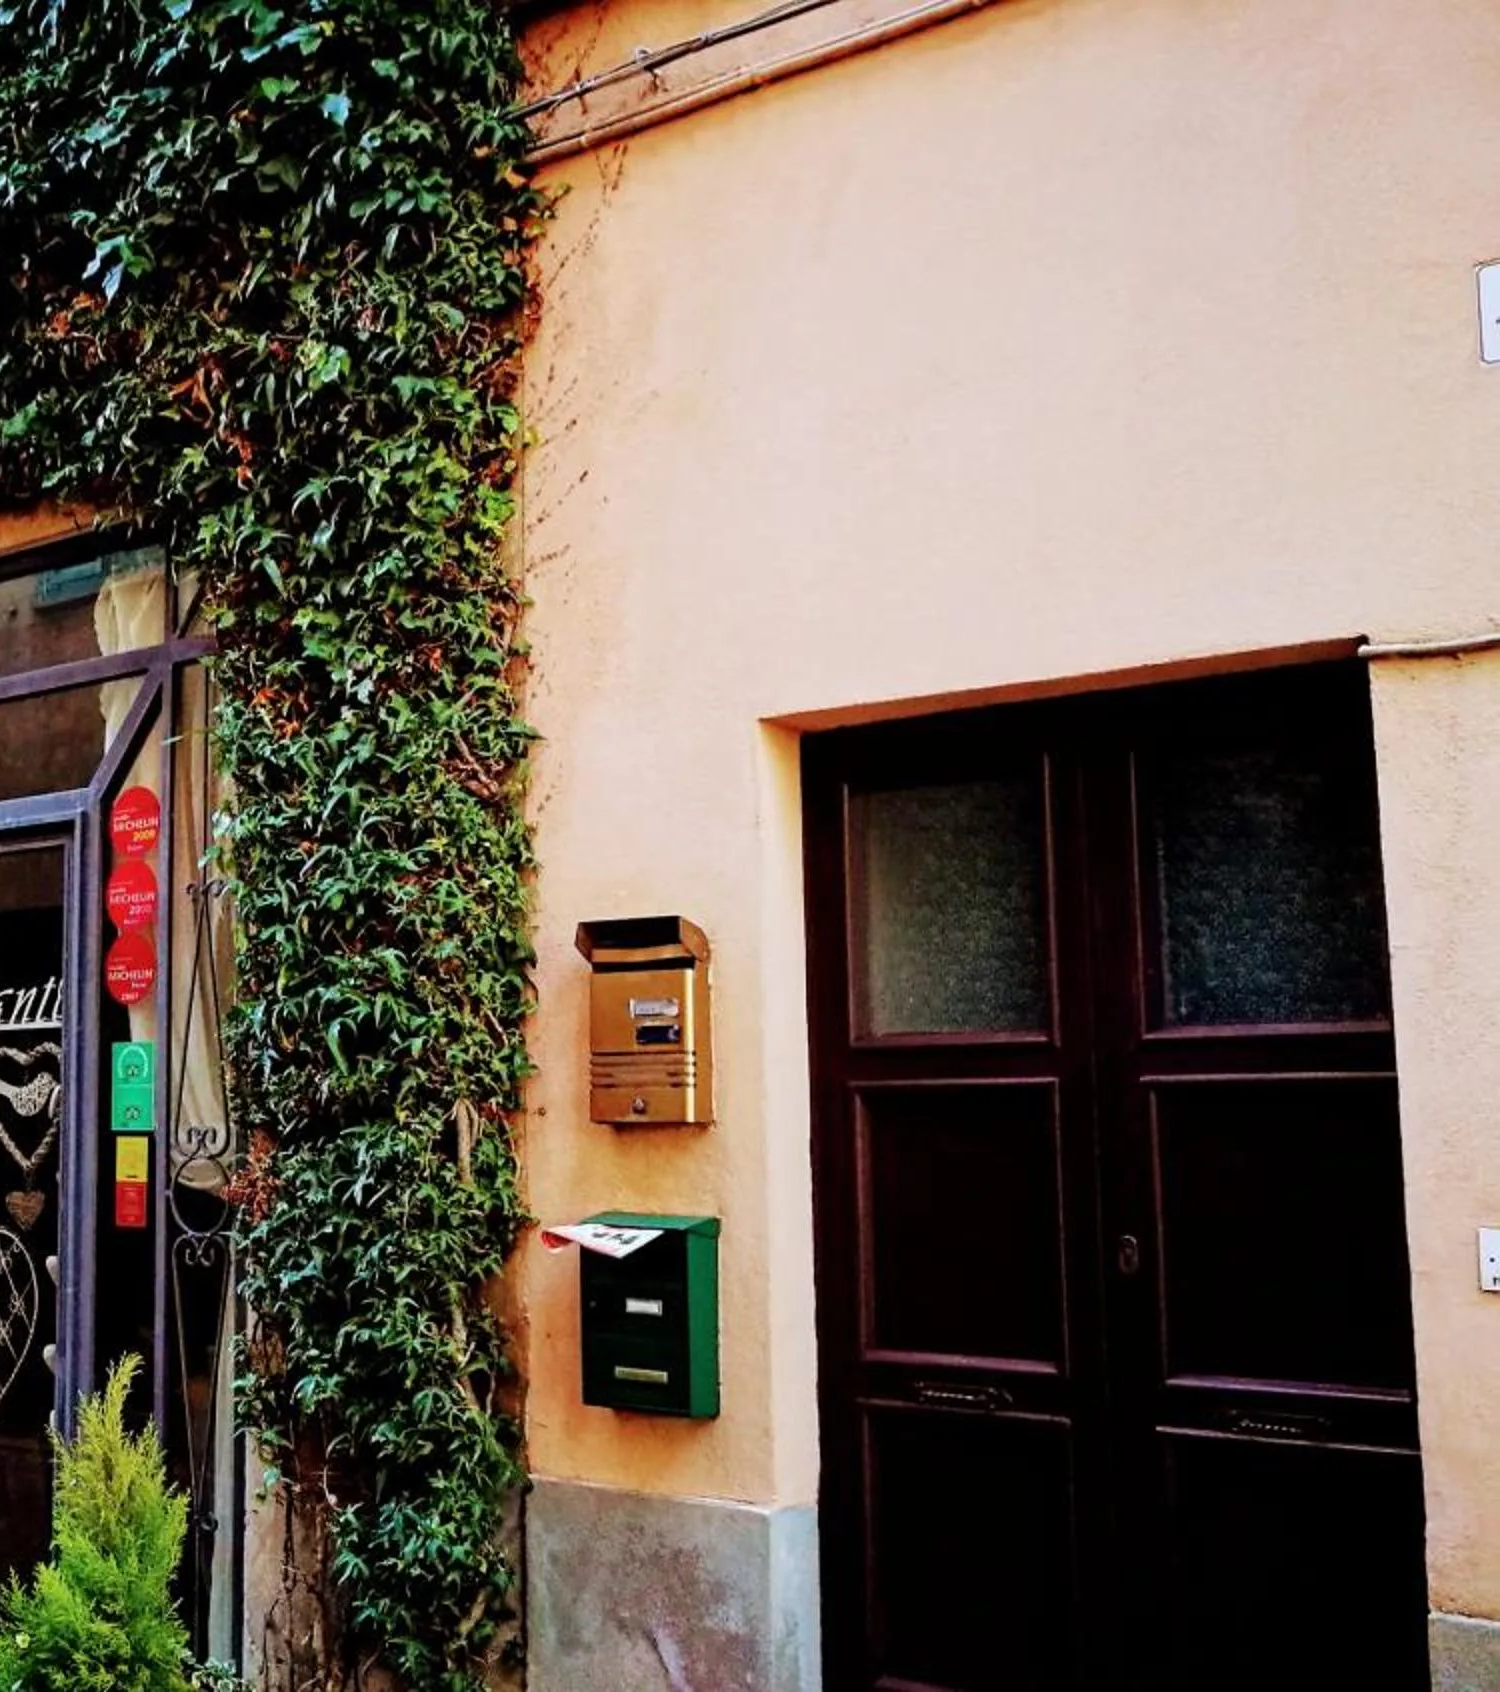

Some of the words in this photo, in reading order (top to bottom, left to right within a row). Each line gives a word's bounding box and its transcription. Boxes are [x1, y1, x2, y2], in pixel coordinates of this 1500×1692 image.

[113, 816, 159, 832] MICHELIN
[109, 891, 155, 904] MICHELIN
[107, 968, 153, 981] MICHELIN
